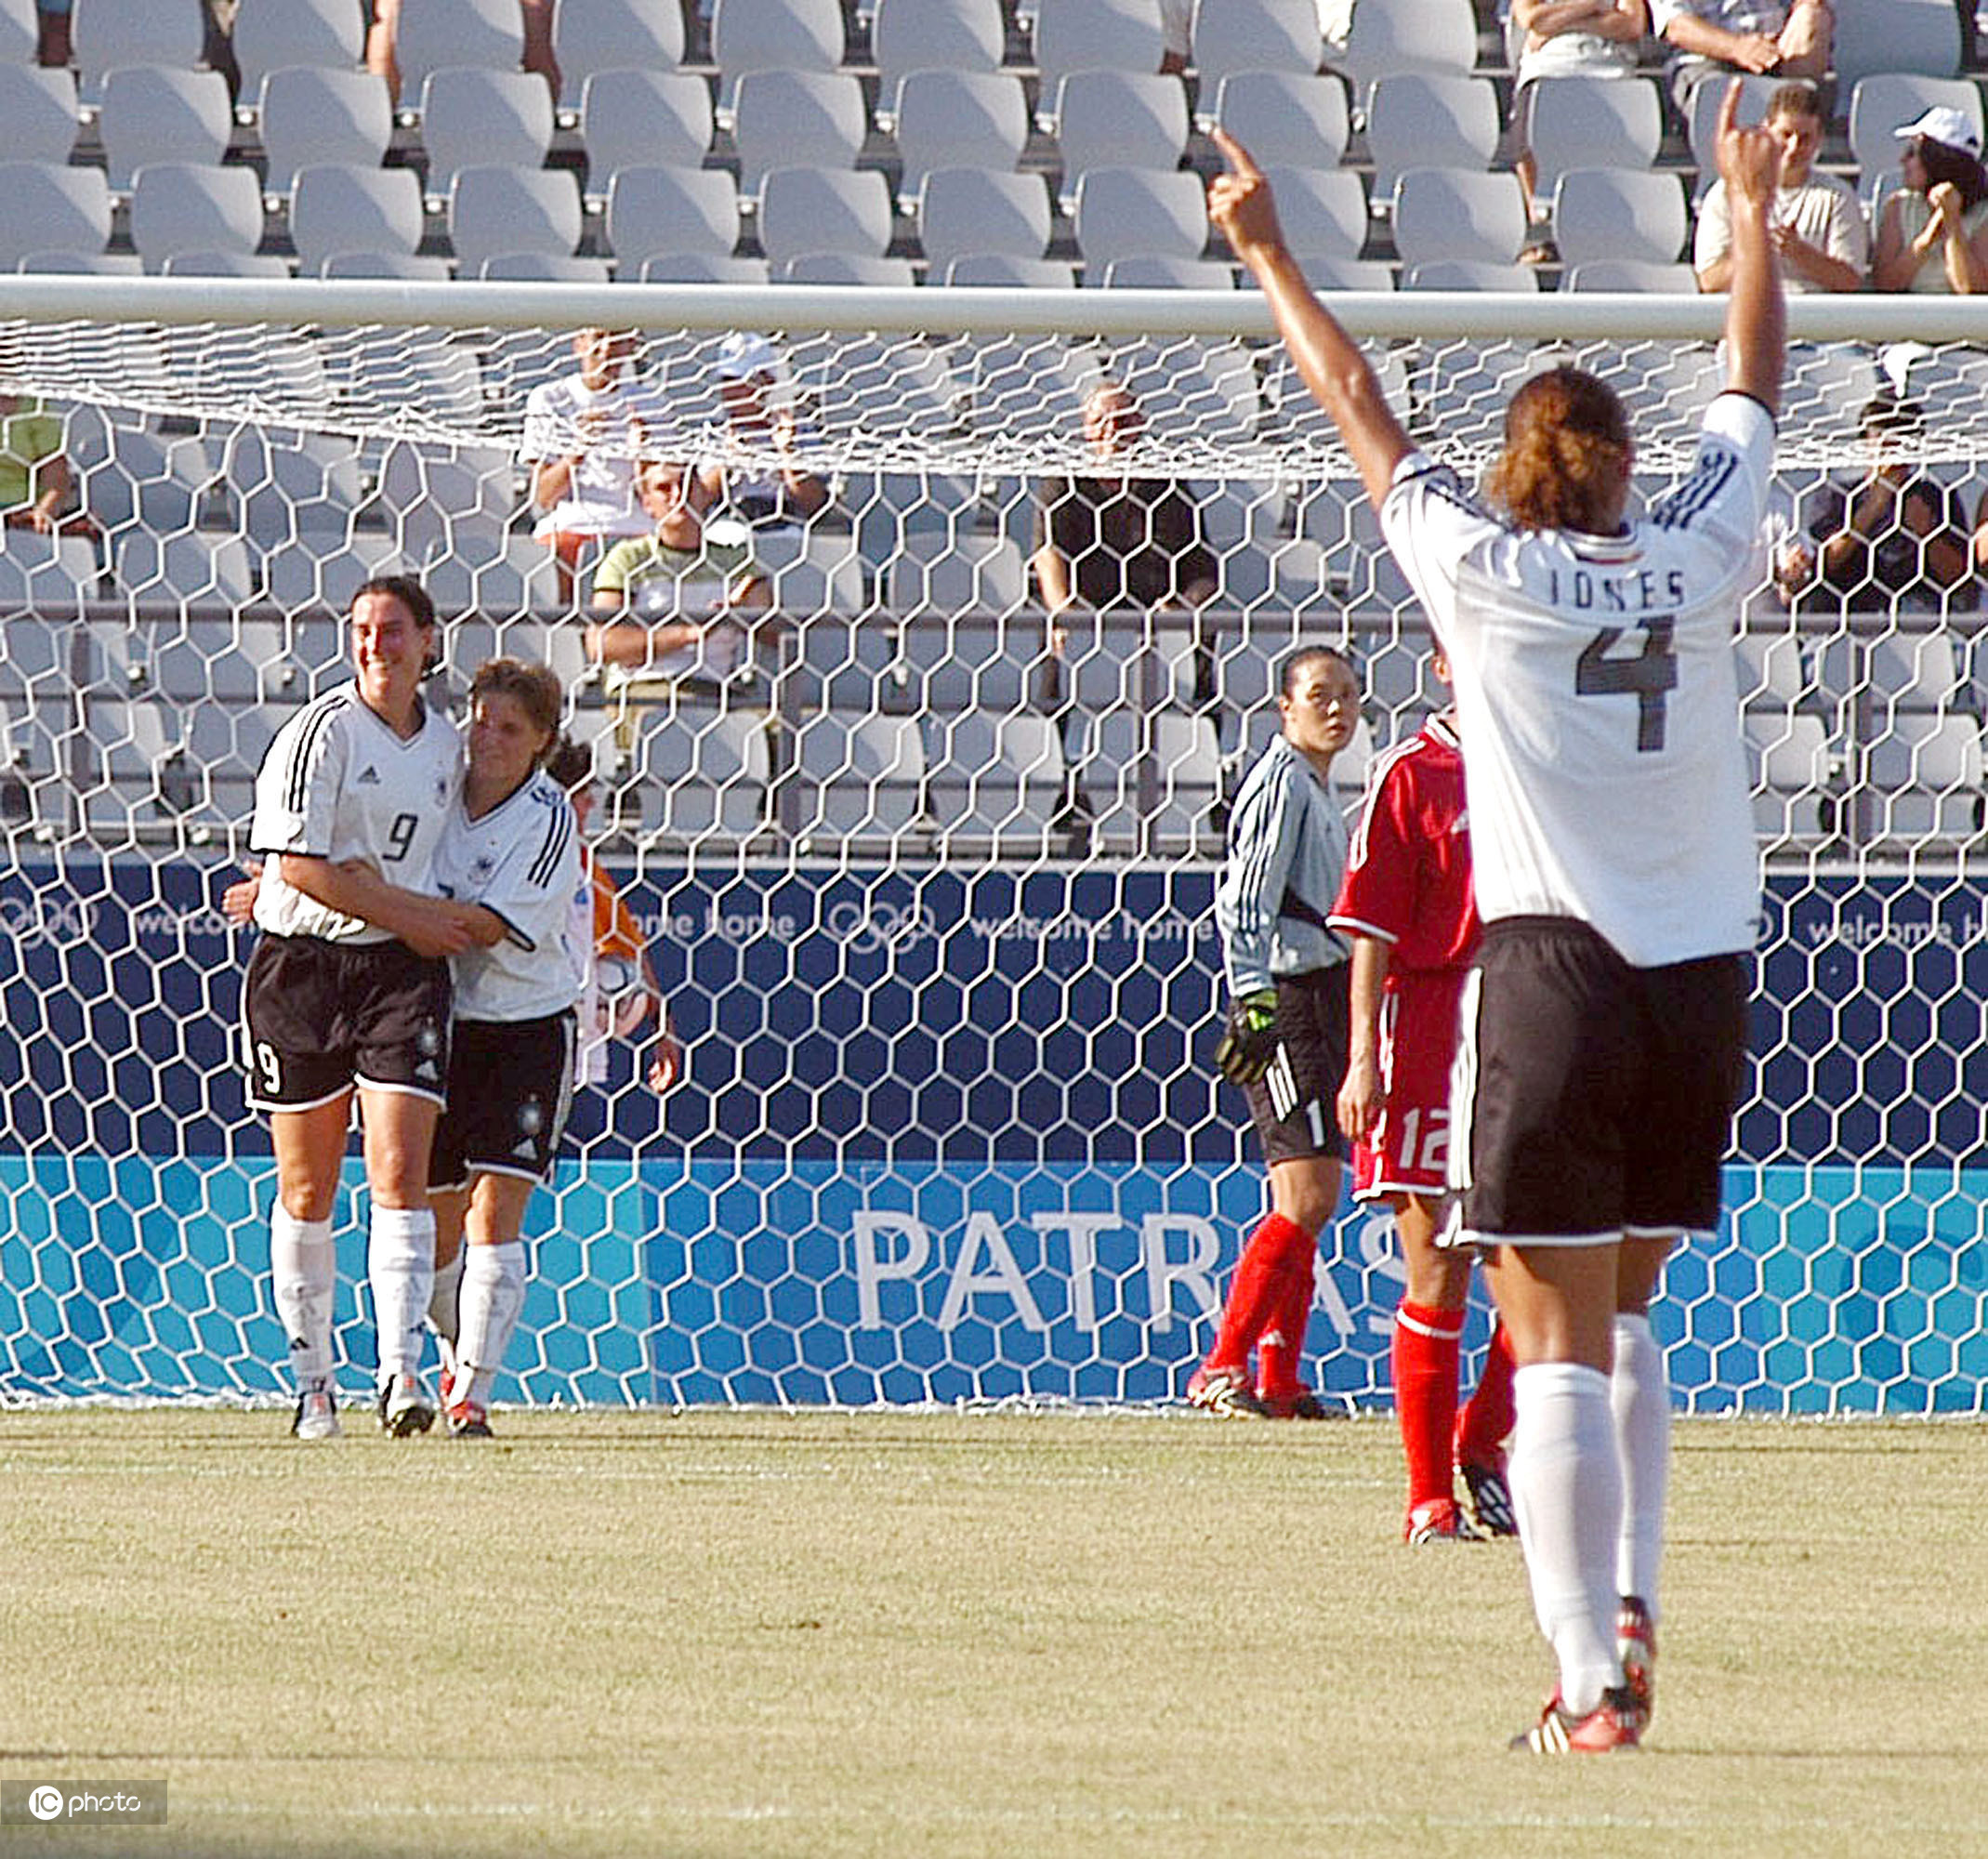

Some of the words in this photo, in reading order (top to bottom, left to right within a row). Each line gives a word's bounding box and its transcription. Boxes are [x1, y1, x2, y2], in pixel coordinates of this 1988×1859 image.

[1576, 614, 1678, 752] 4
[381, 813, 418, 861] 9
[705, 906, 796, 938] home
[970, 911, 1112, 942] welcome
[1122, 908, 1214, 942] home
[1809, 914, 1953, 944] welcome
[256, 1043, 281, 1092] 9
[1307, 1099, 1325, 1149] 1
[1399, 1107, 1451, 1170] 12
